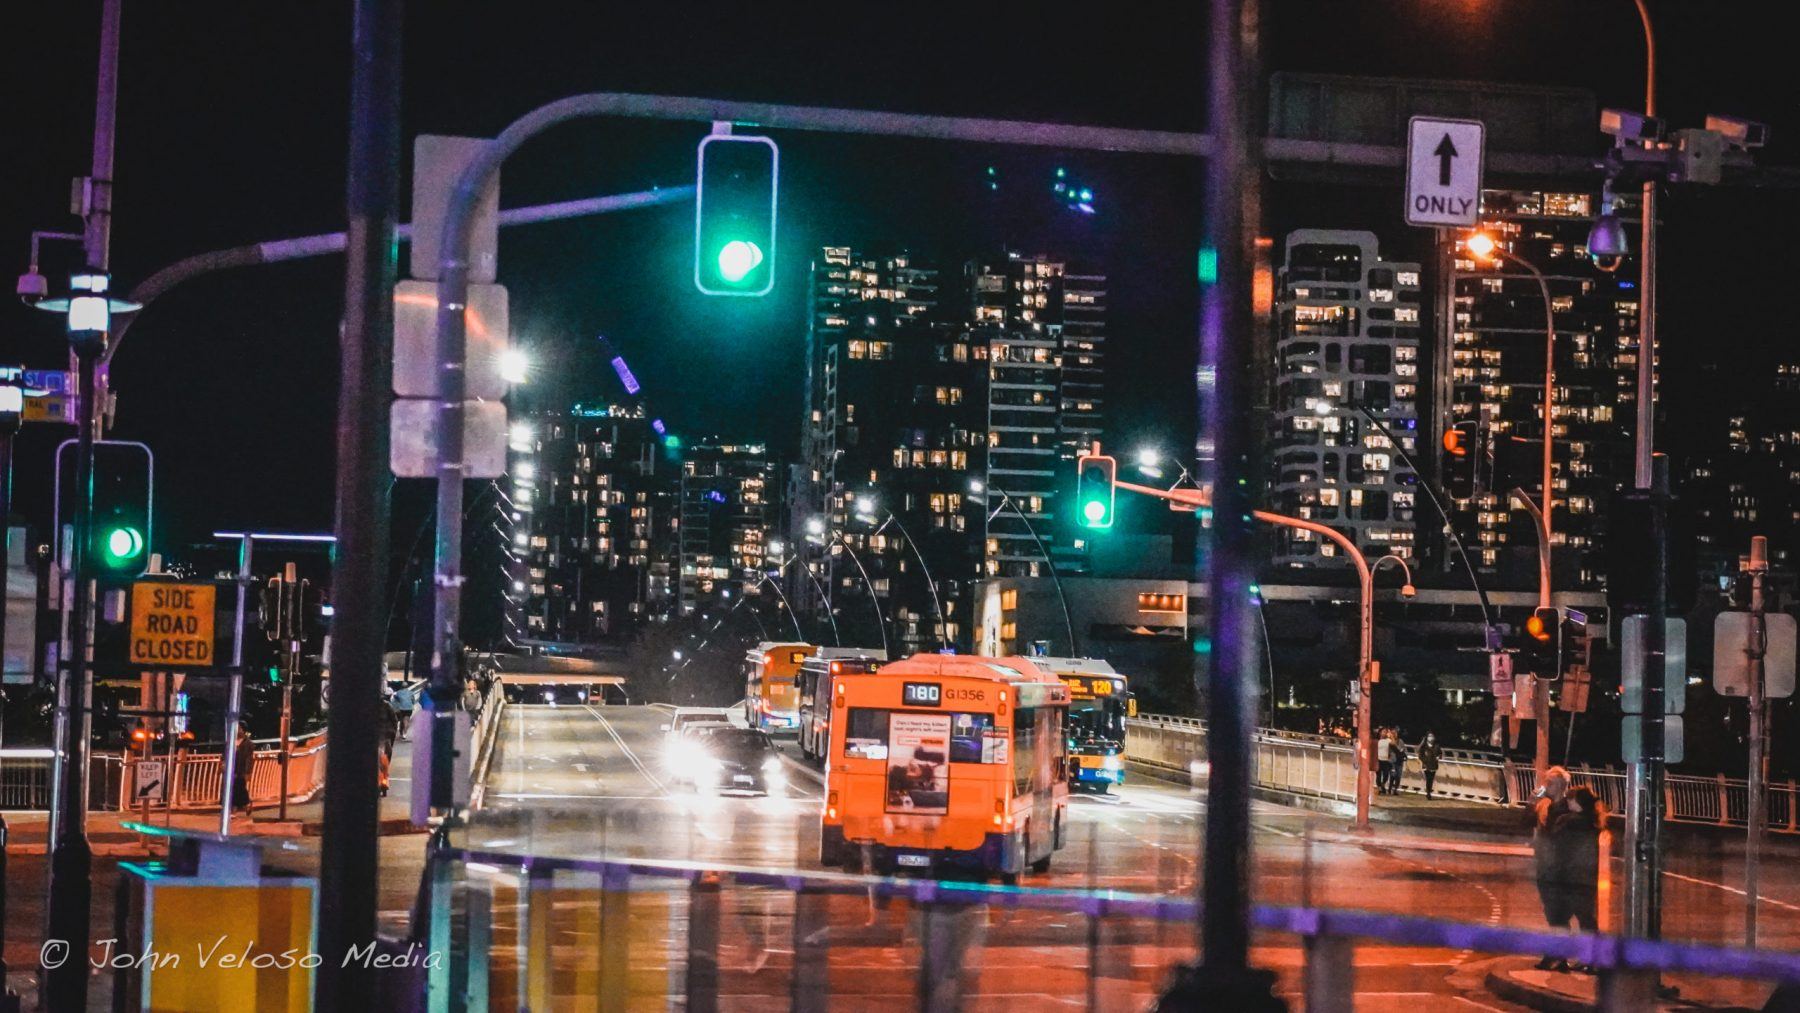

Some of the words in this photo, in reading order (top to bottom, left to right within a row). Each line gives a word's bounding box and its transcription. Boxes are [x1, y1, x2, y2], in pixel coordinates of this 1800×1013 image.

[1415, 194, 1473, 215] ONLY
[153, 588, 195, 609] SIDE
[147, 614, 198, 634] ROAD
[135, 638, 208, 660] CLOSED
[945, 688, 985, 701] G1356
[1091, 680, 1113, 695] 120
